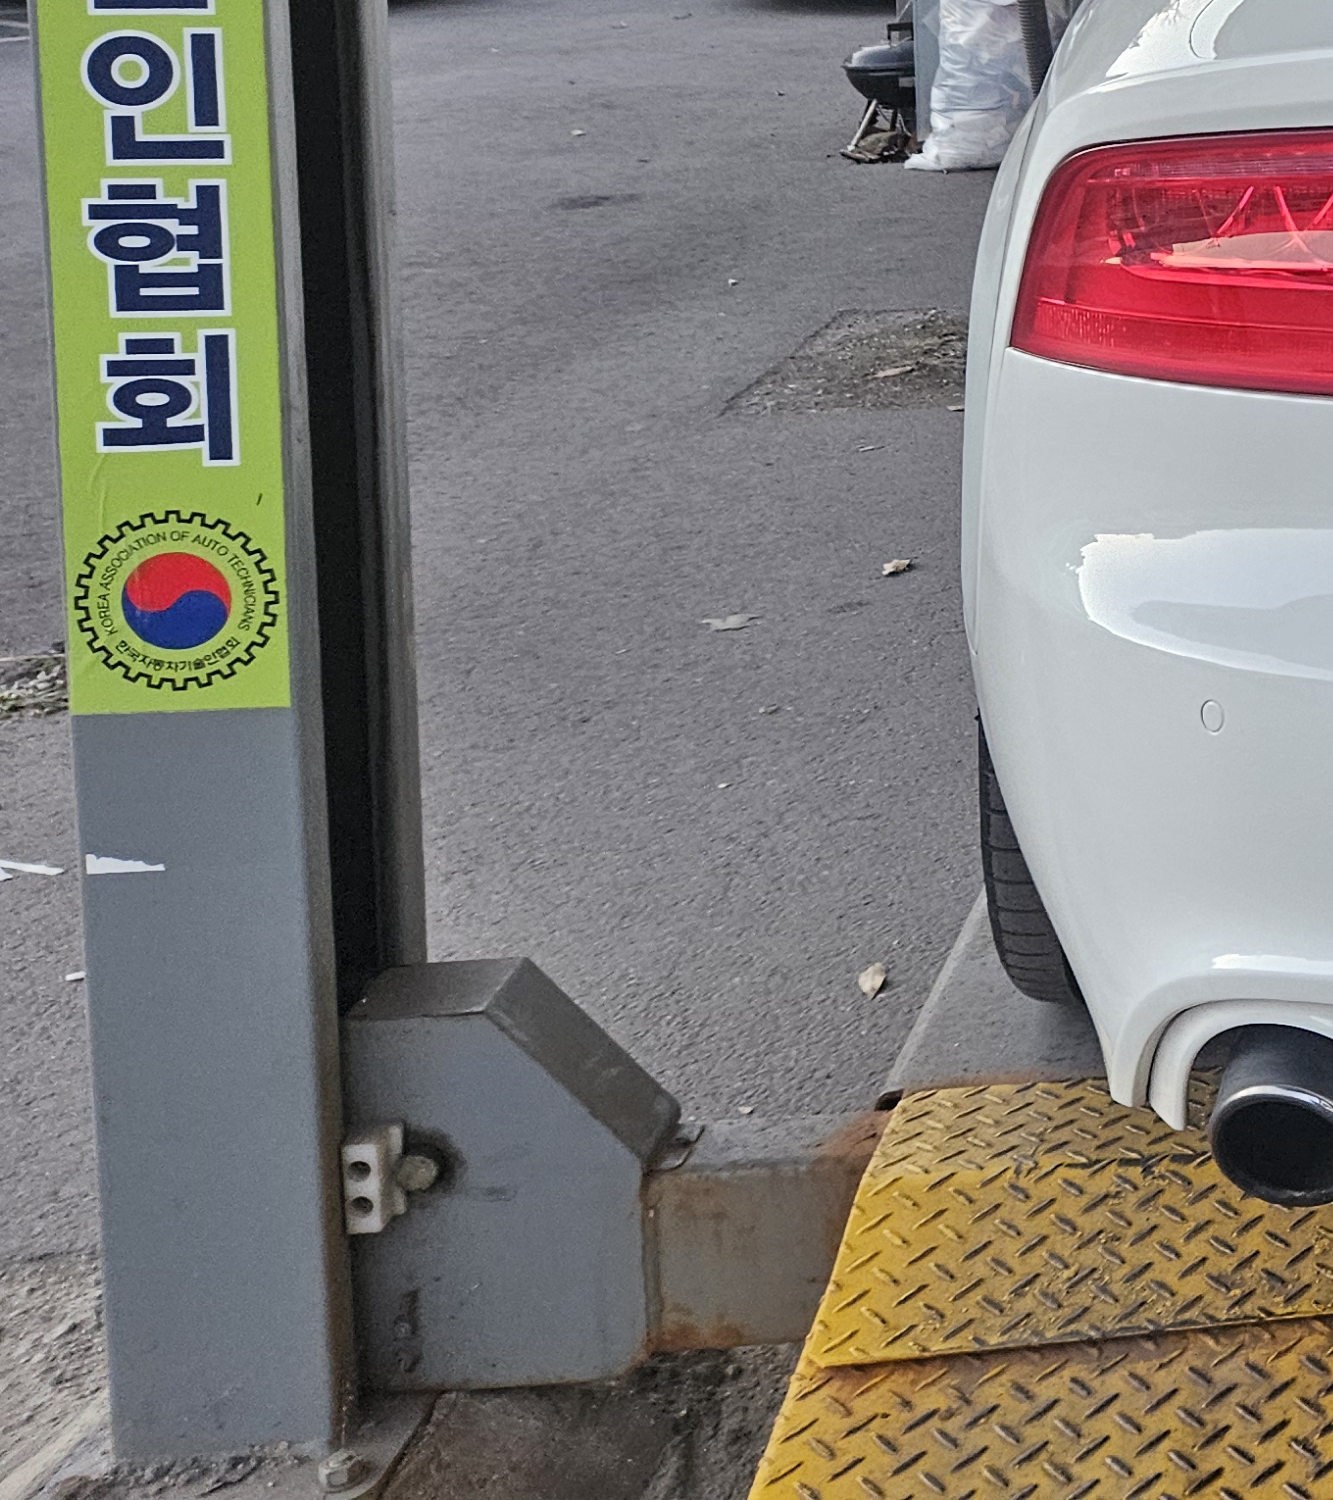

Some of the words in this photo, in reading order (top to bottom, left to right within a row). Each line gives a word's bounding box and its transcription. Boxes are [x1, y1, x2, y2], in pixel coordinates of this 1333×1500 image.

[170, 530, 191, 542] OF
[191, 533, 230, 557] AUTO
[98, 532, 167, 592] ASSOCIATION
[97, 592, 119, 637] KOREA
[226, 553, 257, 632] TECHNICIANS
